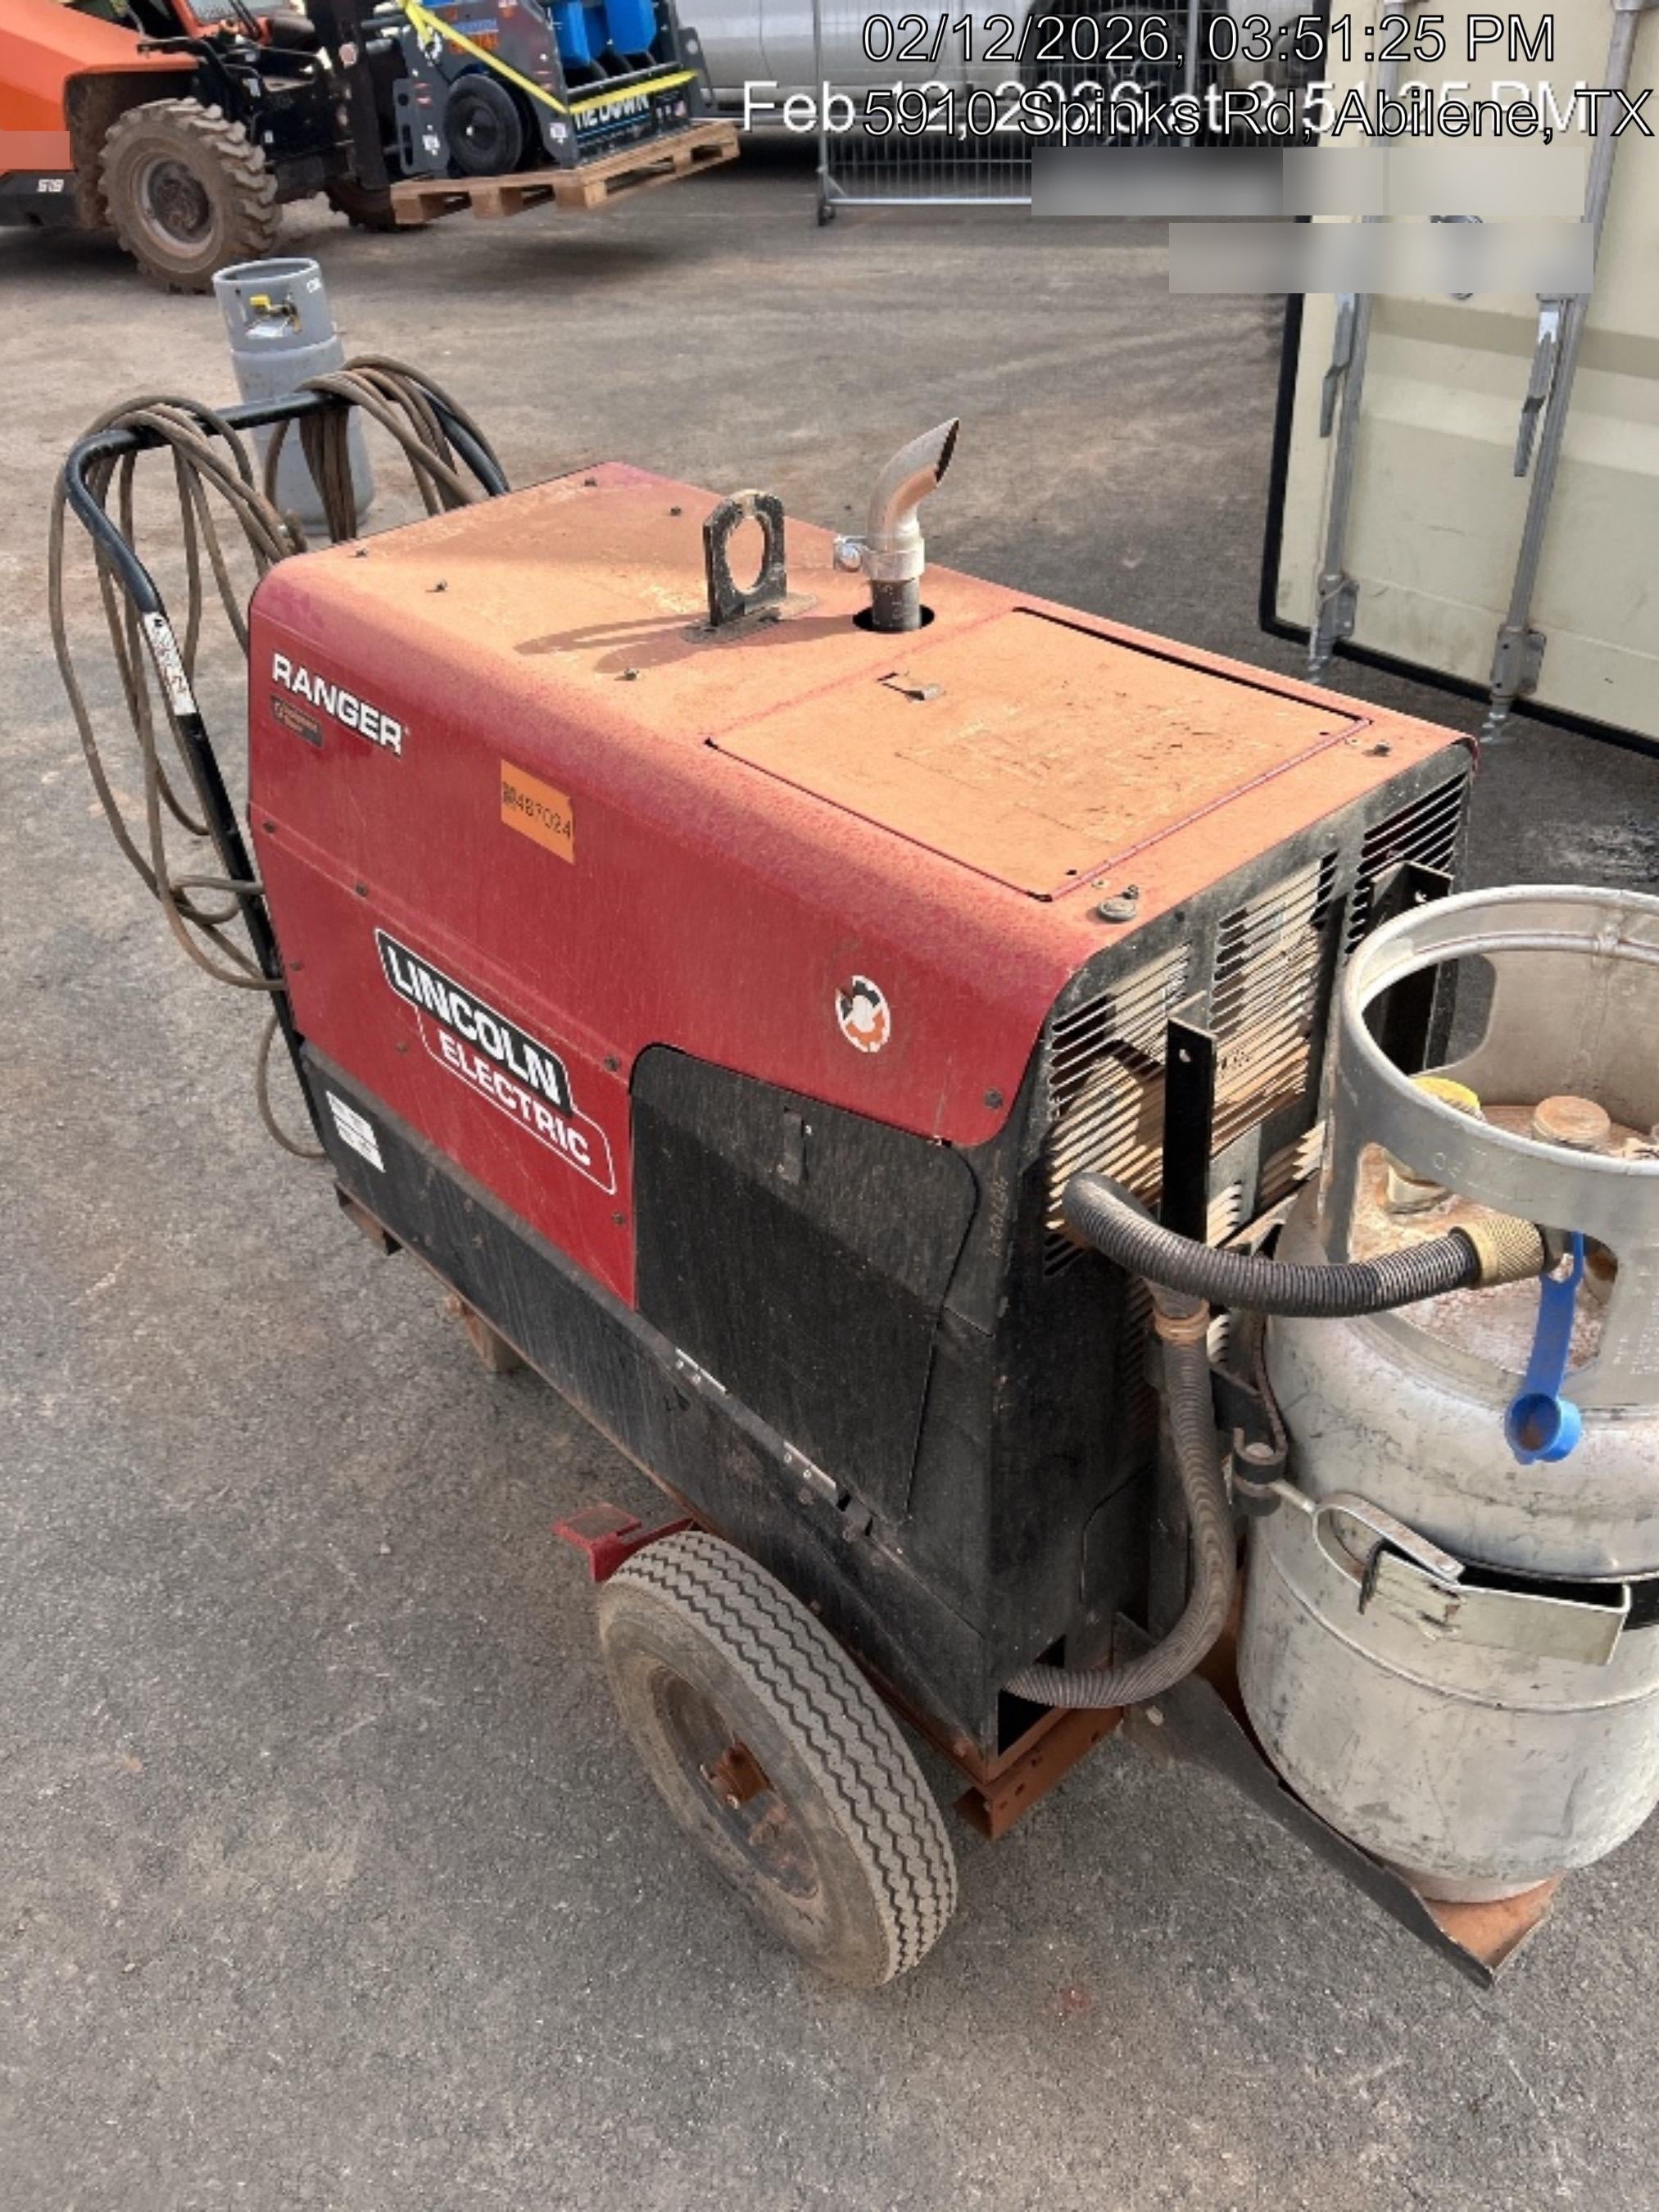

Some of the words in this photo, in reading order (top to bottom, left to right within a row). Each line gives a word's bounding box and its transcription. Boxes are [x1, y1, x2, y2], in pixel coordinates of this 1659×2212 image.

[272, 653, 401, 755] RANGER
[388, 945, 561, 1105] LINCOLN
[438, 1028, 592, 1166] ELECTRIC
